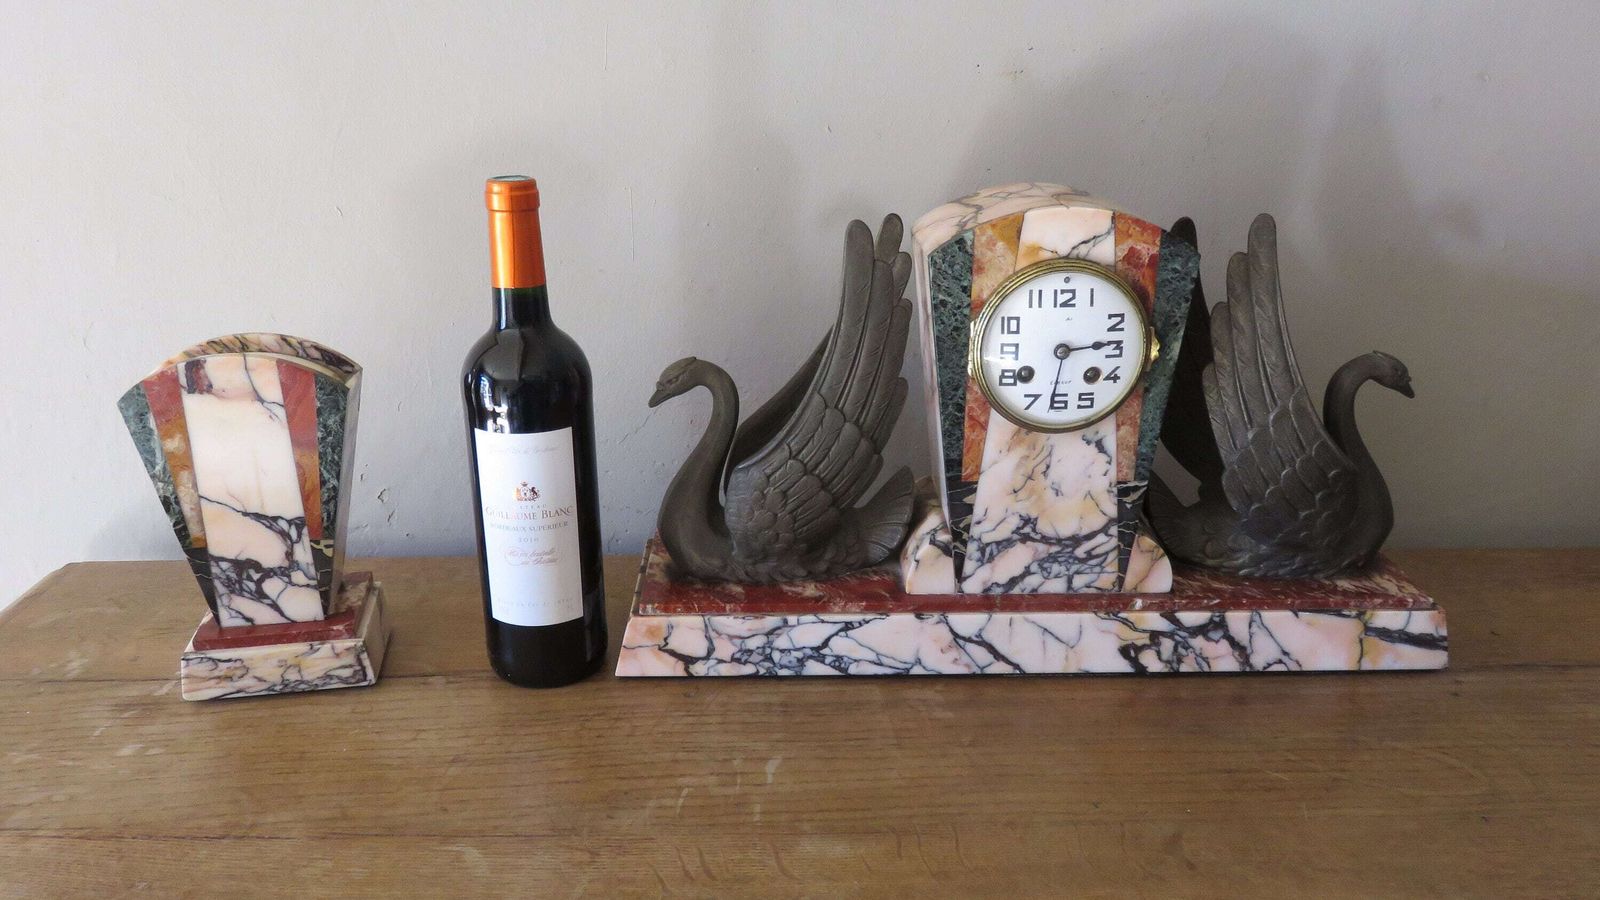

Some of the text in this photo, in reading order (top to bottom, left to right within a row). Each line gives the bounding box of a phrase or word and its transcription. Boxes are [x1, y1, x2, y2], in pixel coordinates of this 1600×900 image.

[1028, 289, 1043, 309] 11
[1053, 288, 1077, 309] 12
[1090, 288, 1094, 307] 1
[1000, 316, 1021, 335] 10
[1106, 312, 1125, 333] 2
[999, 342, 1020, 361] 9
[1104, 339, 1124, 359] 3
[998, 368, 1018, 387] 8
[1102, 365, 1121, 384] 4
[1023, 393, 1043, 411] 7
[1049, 392, 1069, 410] 6
[1076, 391, 1095, 410] 5
[485, 504, 574, 521] GUILLAUME BLANC
